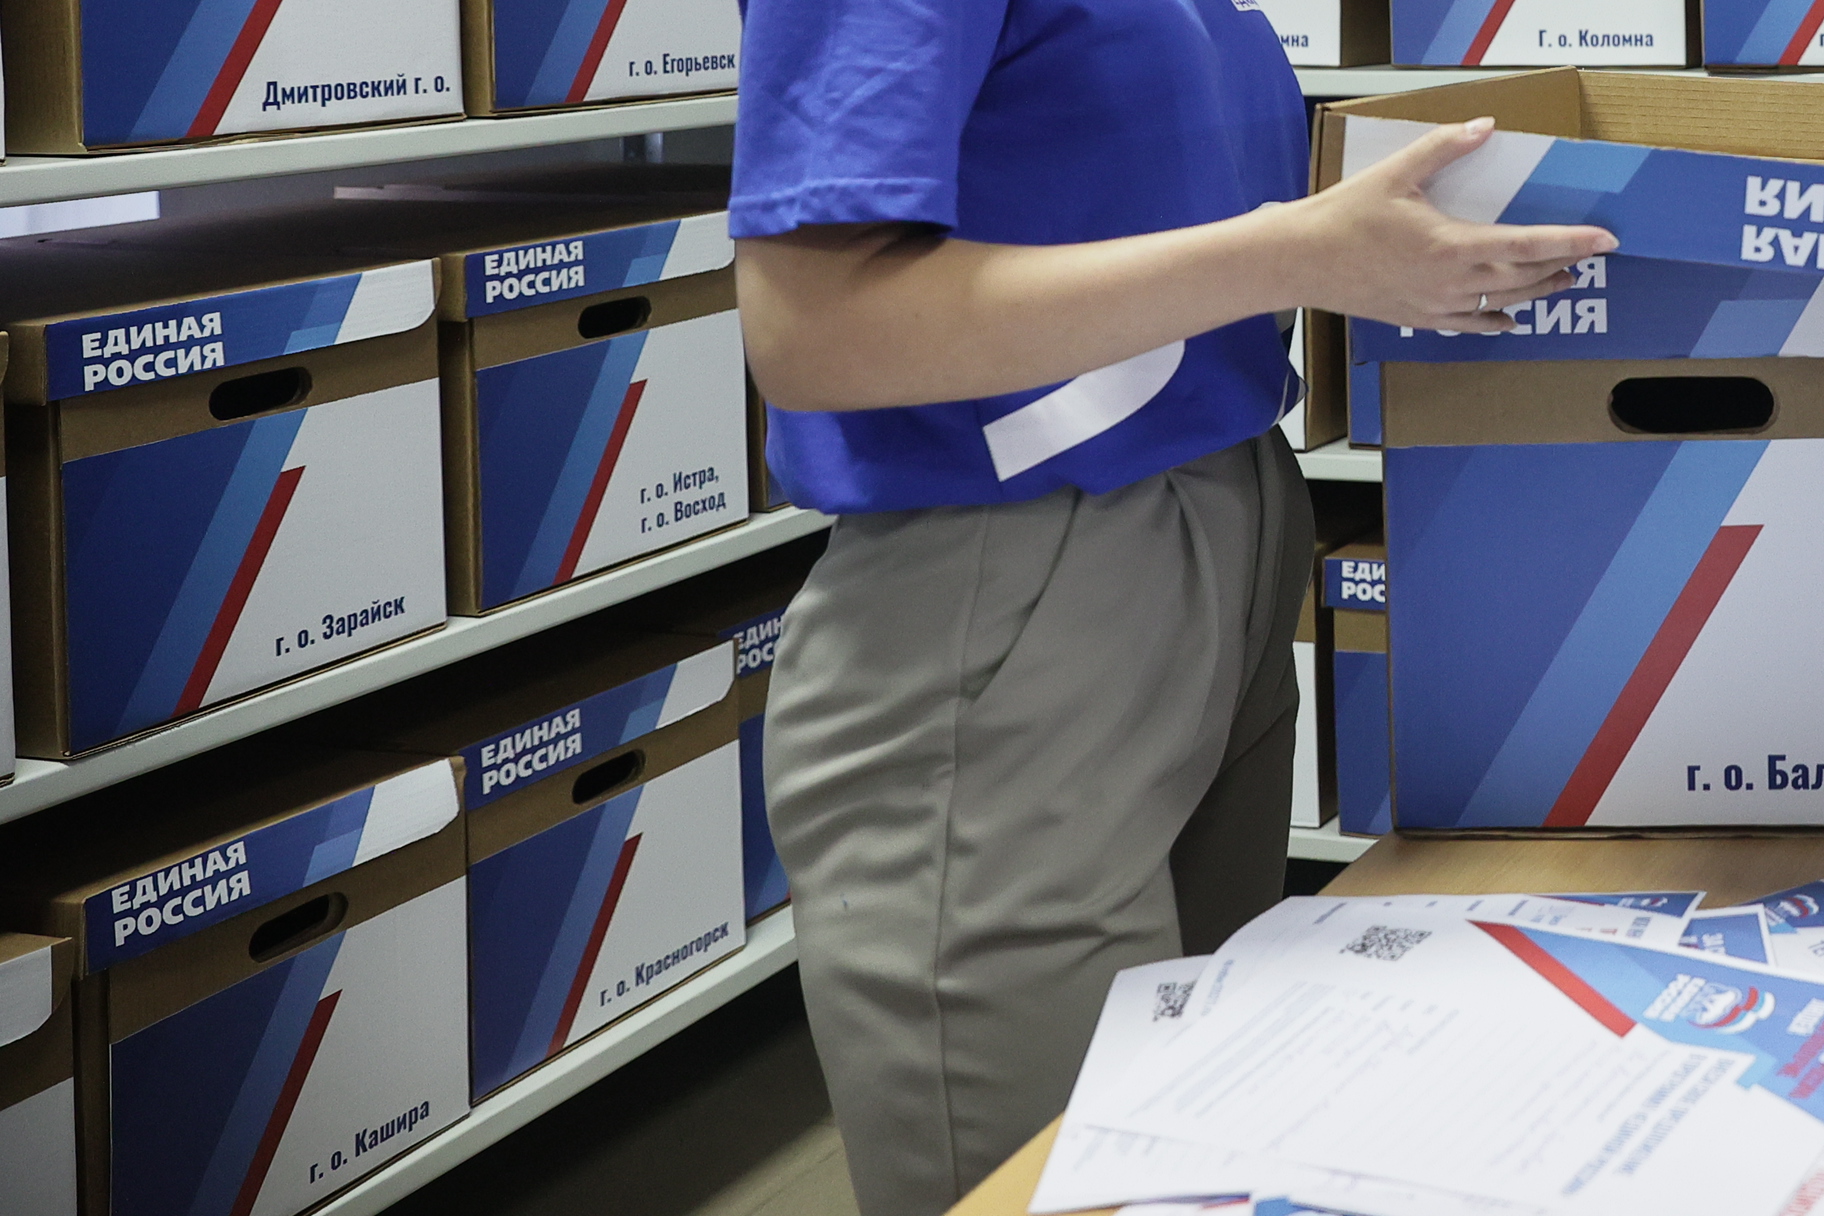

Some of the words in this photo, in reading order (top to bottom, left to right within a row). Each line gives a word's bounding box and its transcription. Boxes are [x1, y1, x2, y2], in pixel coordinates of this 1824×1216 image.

[1558, 34, 1572, 48] о.
[1578, 29, 1654, 47] Коломна
[629, 61, 640, 77] г.
[644, 60, 658, 76] о.
[662, 53, 736, 77] Егорьевск
[262, 73, 407, 112] Дмитровский
[414, 77, 428, 95] г.
[434, 75, 450, 93] о.
[484, 240, 584, 276] ЕДИНАЯ
[485, 265, 585, 304] РОССИЯ
[81, 311, 223, 359] ЕДИНАЯ
[83, 341, 225, 392] РОССИЯ
[640, 488, 651, 504] г.
[655, 482, 669, 499] о.
[673, 466, 719, 494] Истра,
[641, 517, 652, 534] г.
[656, 512, 670, 528] о.
[674, 492, 727, 523] Восход
[1341, 560, 1386, 582] ЕДИ
[1341, 581, 1386, 603] РОС
[275, 636, 290, 657] г.
[297, 629, 315, 649] о.
[321, 596, 405, 640] Зарайск
[736, 642, 774, 675] РОС
[481, 708, 582, 768] ЕДИНАЯ
[482, 732, 582, 795] РОССИЯ
[1687, 765, 1711, 792] г.
[1723, 764, 1754, 791] о.
[111, 840, 247, 914] ЕДИНАЯ
[114, 870, 251, 947] РОССИЯ
[600, 989, 612, 1007] г.
[616, 980, 631, 997] о.
[635, 921, 729, 987] Красногорск
[309, 1163, 324, 1184] г.
[330, 1150, 348, 1171] о.
[354, 1100, 430, 1158] Кашира
